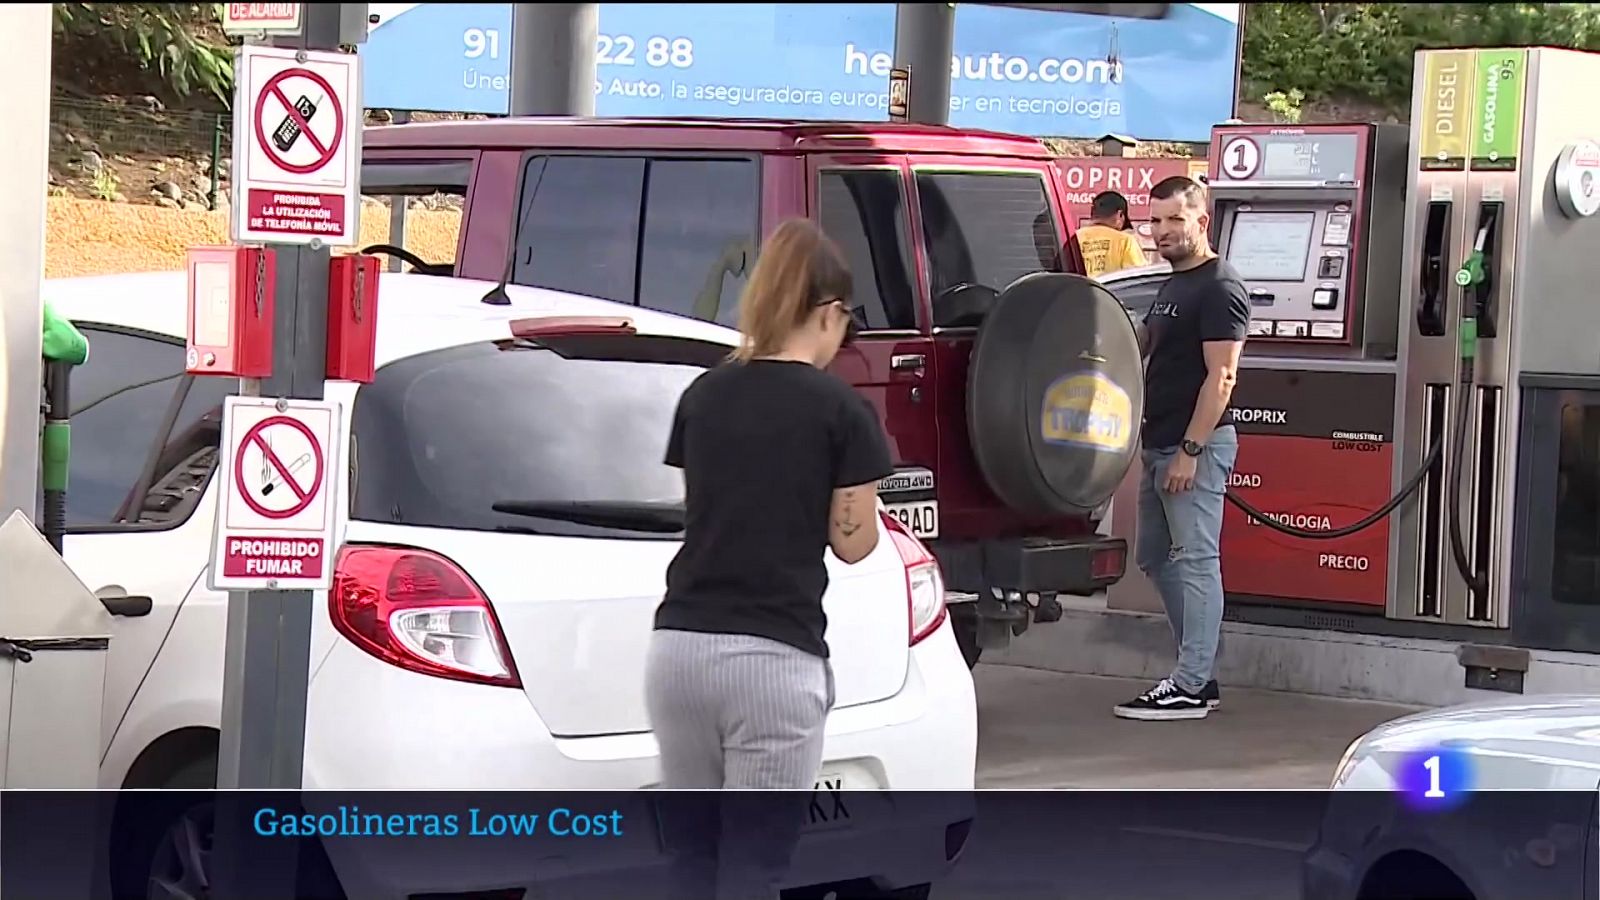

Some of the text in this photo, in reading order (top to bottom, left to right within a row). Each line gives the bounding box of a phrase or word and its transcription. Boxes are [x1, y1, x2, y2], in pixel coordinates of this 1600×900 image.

[463, 28, 499, 59] 91
[646, 36, 693, 68] 88
[1501, 59, 1516, 80] 95
[608, 78, 664, 100] Auto,
[671, 80, 688, 98] la
[694, 84, 823, 105] aseguradora
[975, 97, 1002, 112] en
[1009, 96, 1121, 119] tecnología
[1436, 61, 1458, 134] DIESEL
[1483, 64, 1499, 143] GASOLINA
[1232, 144, 1248, 172] 1
[273, 194, 321, 206] PROHIBIDA
[262, 206, 331, 219] LA UTILIZACIÓN
[251, 218, 342, 232] DE TELEFONÍA MÓVIL
[1229, 408, 1287, 424] ROPRIX
[1332, 431, 1384, 442] COMBUSTIBLE
[1331, 441, 1383, 452] LOW COST
[911, 476, 932, 487] 4WD
[1247, 511, 1331, 530] TNOLOGIA
[230, 540, 319, 557] PROHIBIDO
[246, 559, 303, 574] FUMAR
[1319, 554, 1369, 571] PRECIO
